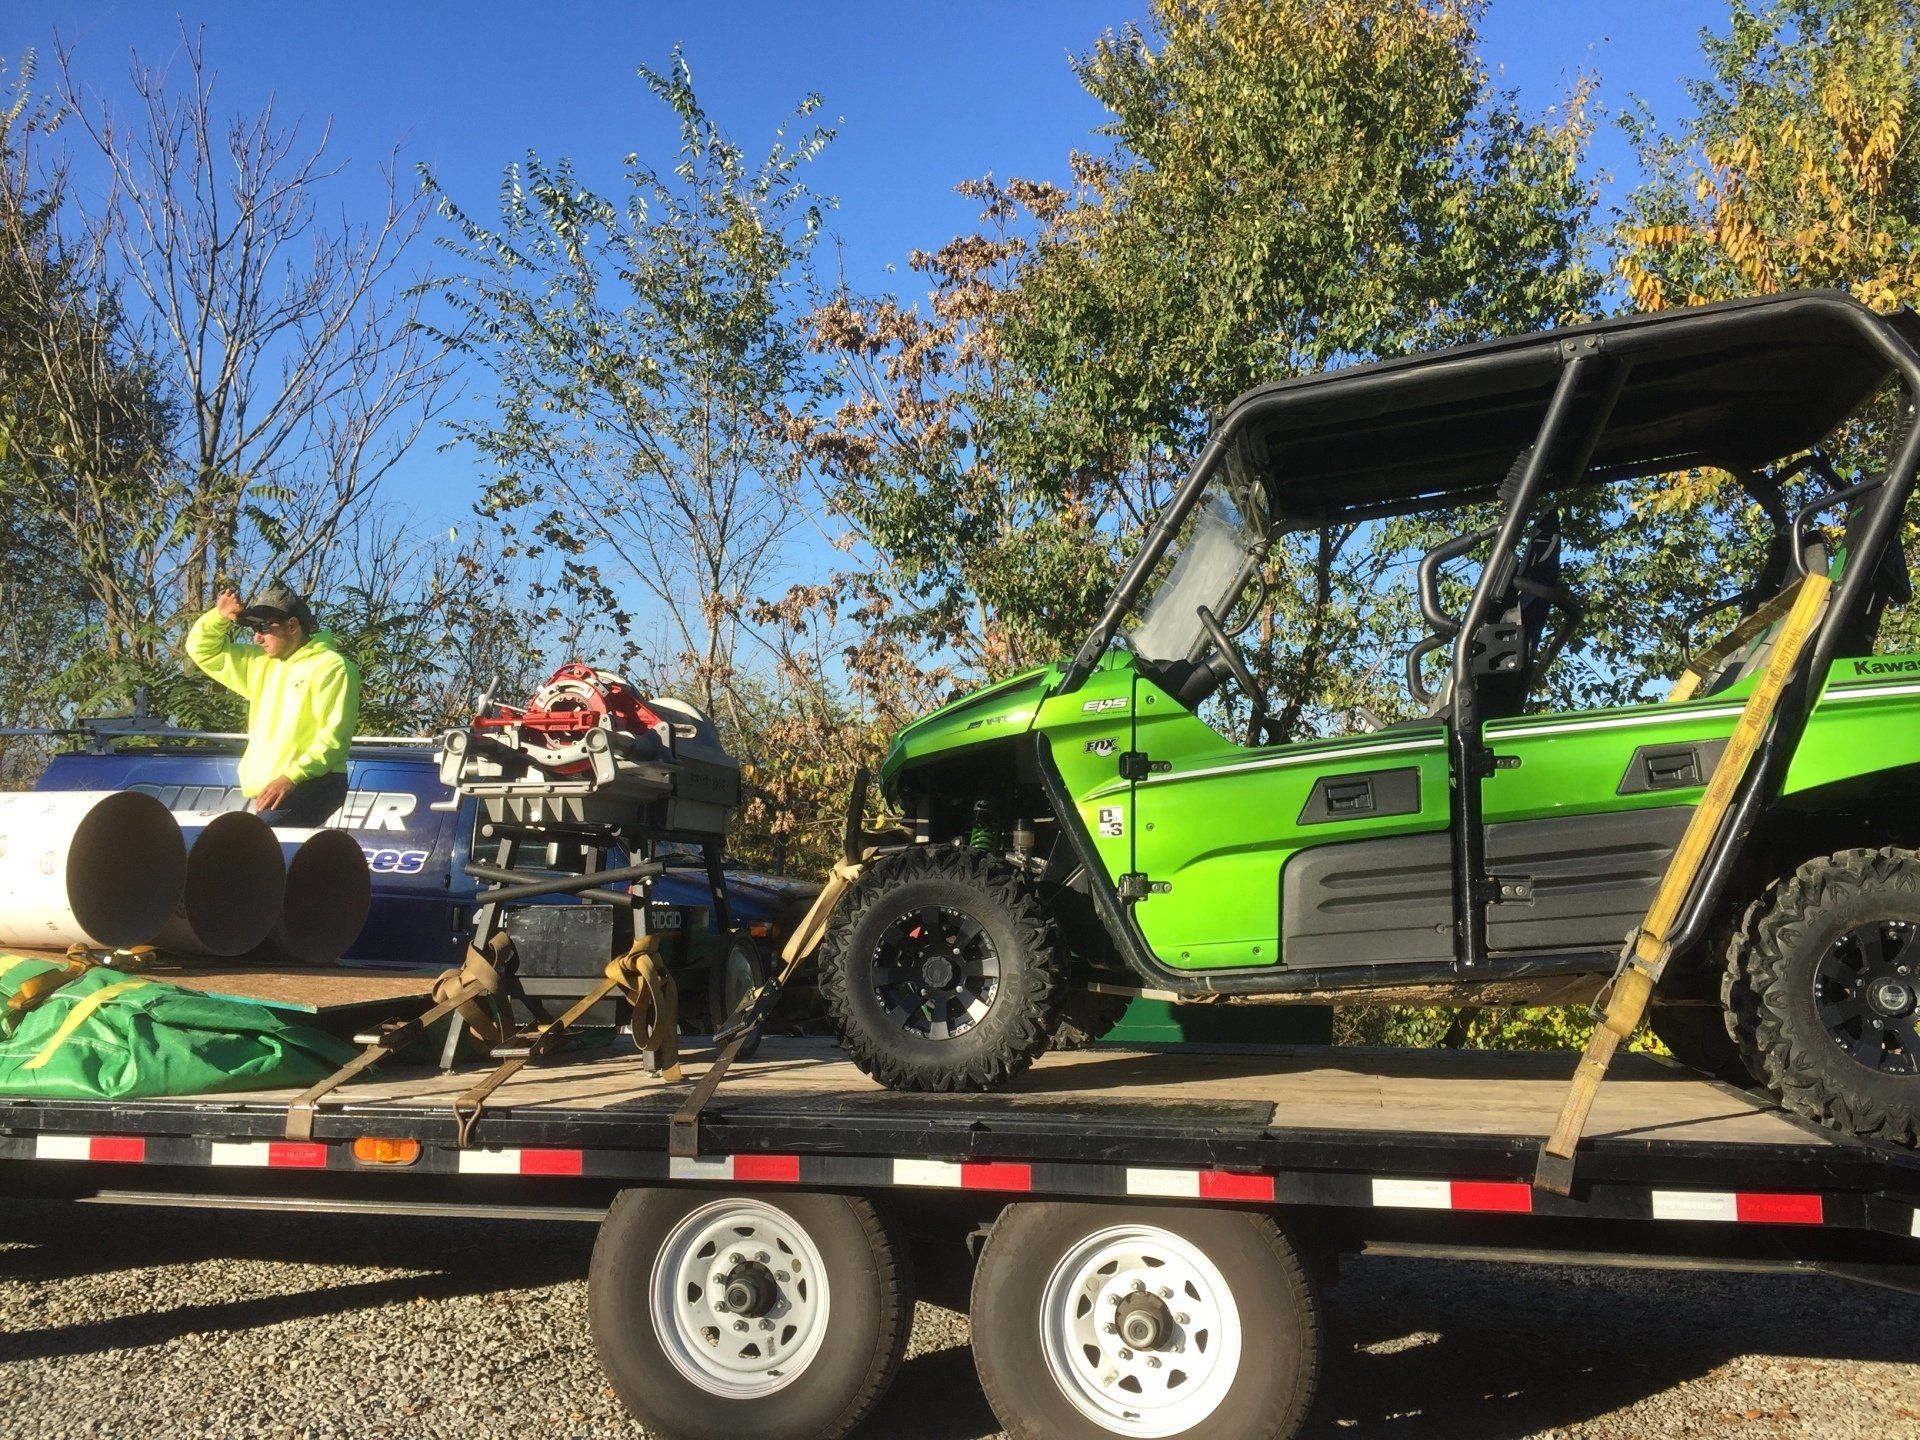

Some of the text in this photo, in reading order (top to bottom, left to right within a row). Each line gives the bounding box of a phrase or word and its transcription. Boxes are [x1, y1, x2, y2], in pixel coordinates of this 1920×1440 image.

[1853, 660, 1920, 676] Kawa
[1745, 627, 1803, 731] Allied INDUSTRIAL
[1082, 697, 1128, 713] EPS
[1084, 737, 1120, 753] FOX
[651, 911, 682, 929] RIDGID
